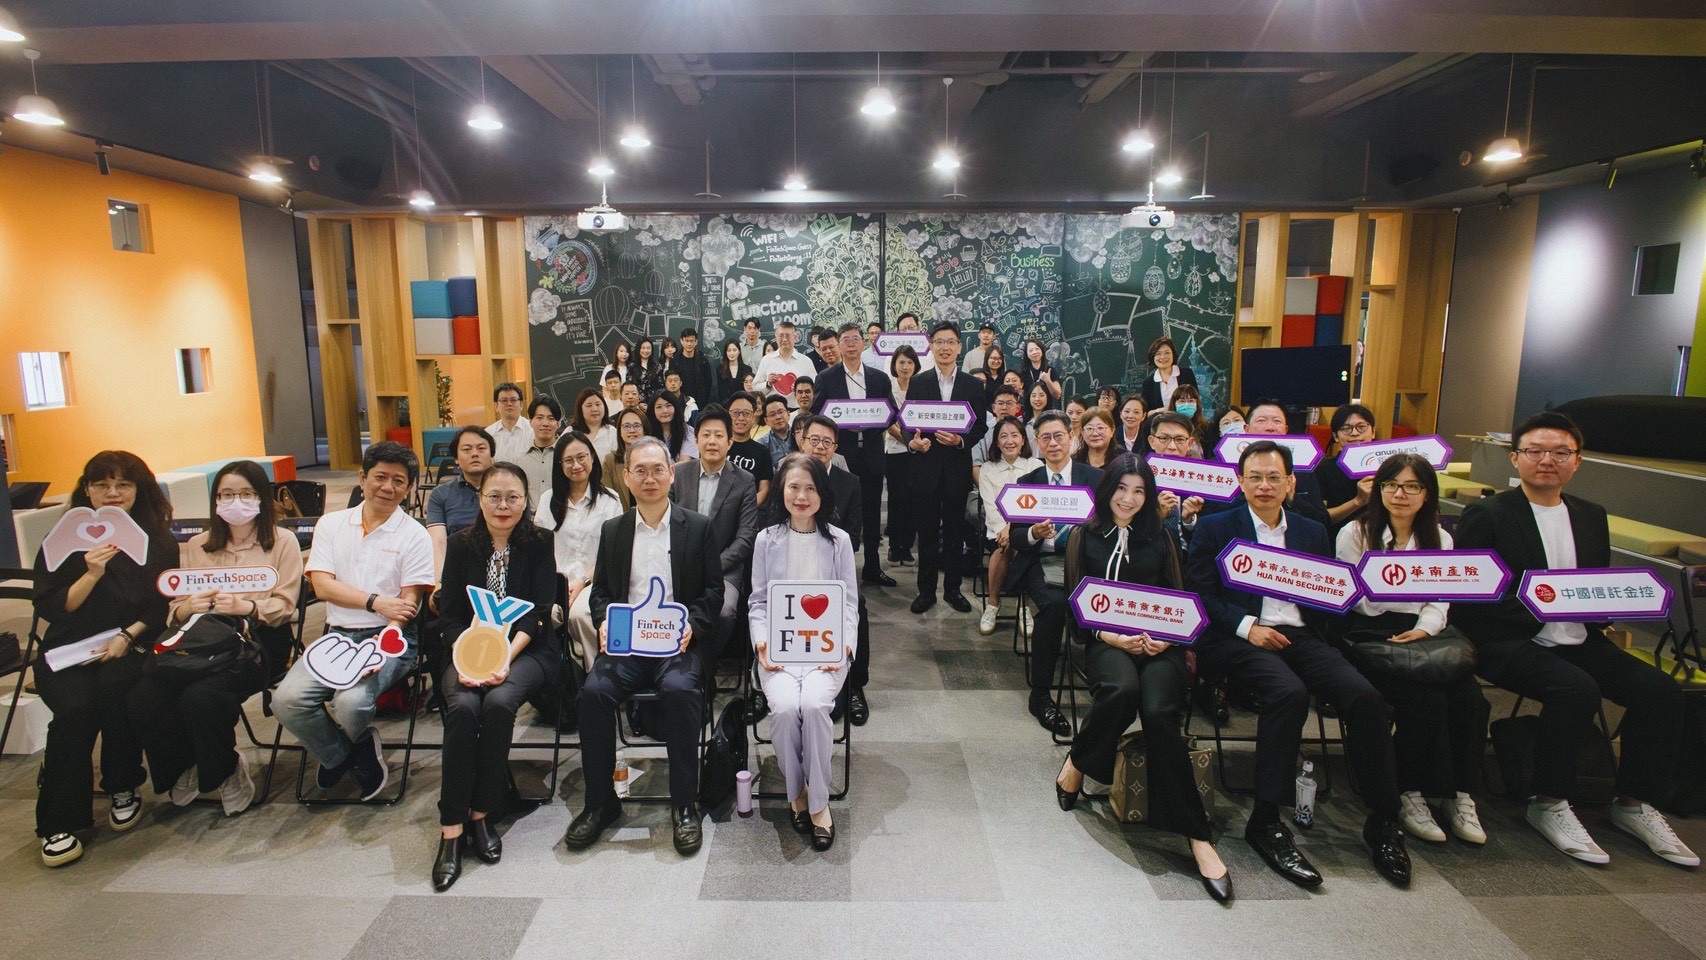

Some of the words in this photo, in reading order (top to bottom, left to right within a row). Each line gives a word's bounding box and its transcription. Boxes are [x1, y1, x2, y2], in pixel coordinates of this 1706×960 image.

[809, 212, 838, 236] IDEA
[1010, 253, 1055, 268] Business
[731, 294, 798, 321] Function
[186, 573, 267, 585] FinTechSpace
[1256, 571, 1273, 580] HUA
[1275, 575, 1294, 585] NAN
[1295, 581, 1345, 597] SECURITIES
[1561, 586, 1655, 600] 中國信託金控
[784, 594, 795, 620] I
[1114, 597, 1185, 618] 華南商業銀行
[637, 619, 675, 631] FinTech
[640, 630, 671, 640] Space
[779, 630, 835, 653] FTS
